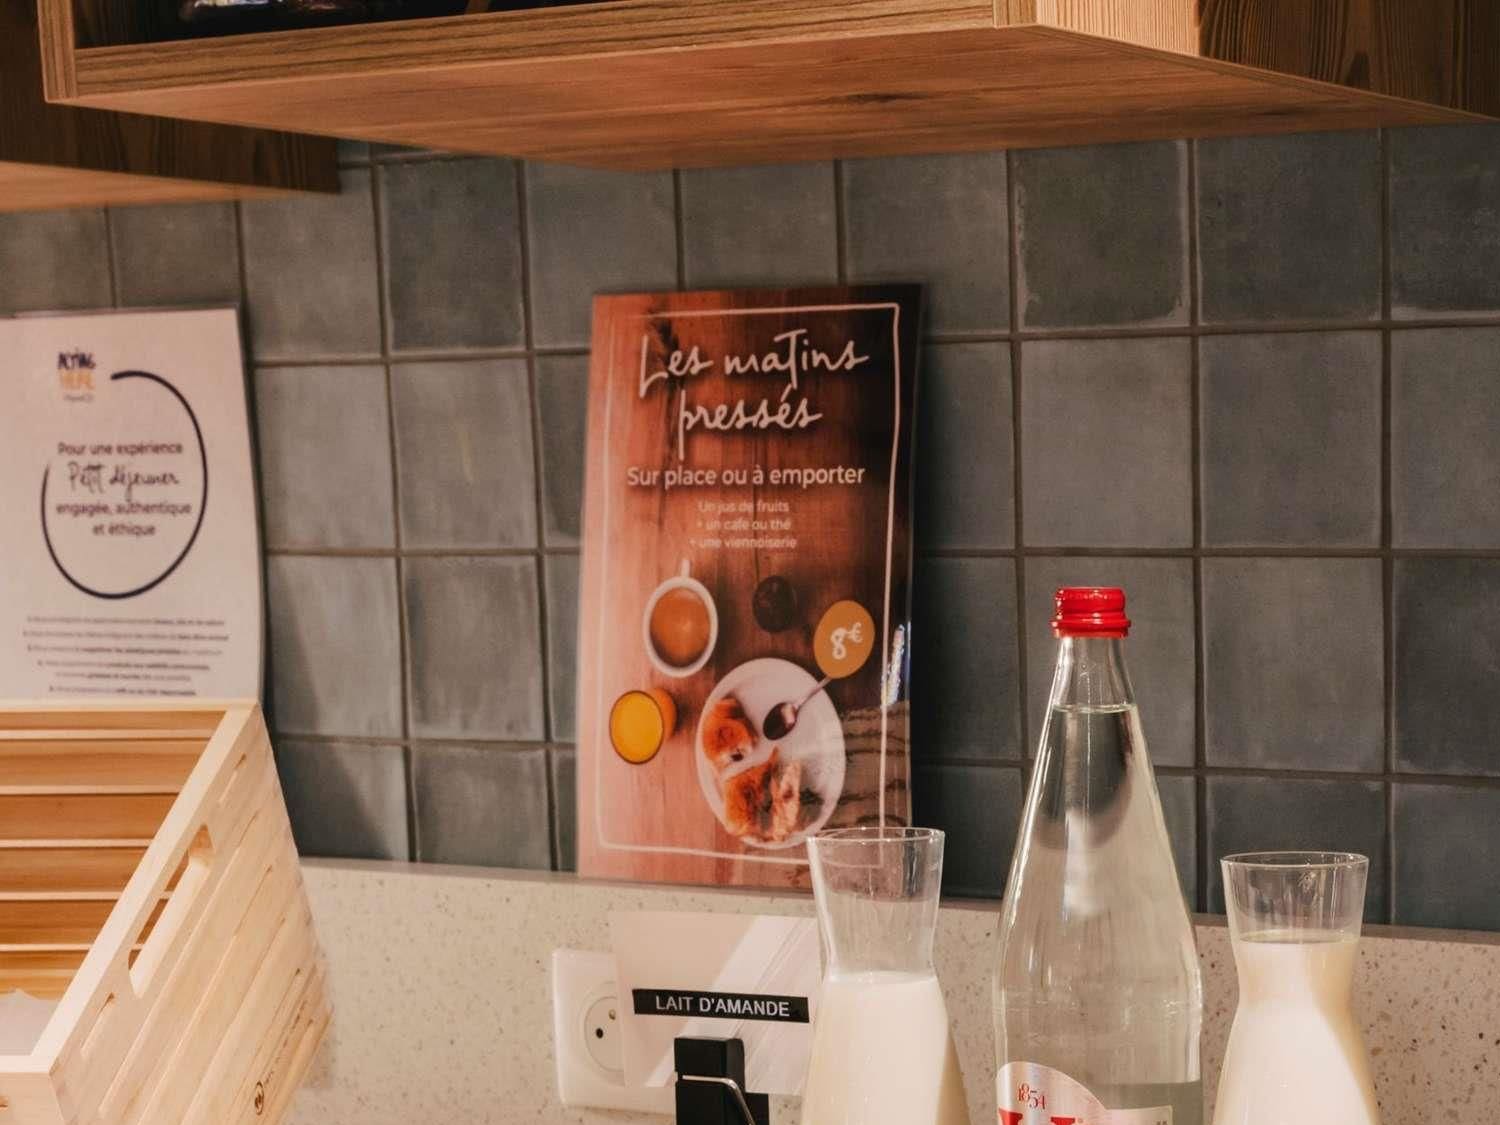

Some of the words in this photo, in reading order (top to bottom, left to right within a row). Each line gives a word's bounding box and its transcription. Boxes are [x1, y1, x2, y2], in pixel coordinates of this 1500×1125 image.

[639, 334, 714, 398] Les
[724, 329, 870, 390] matins
[677, 383, 823, 461] pressés
[57, 441, 86, 455] Pour
[89, 443, 113, 455] une
[116, 442, 183, 457] expérience
[109, 464, 180, 503] déjeuner
[627, 466, 660, 486] Sur
[664, 465, 717, 490] place
[722, 470, 748, 485] ou
[752, 465, 764, 486] à
[769, 466, 867, 489] emporter
[116, 502, 192, 518] authentique
[756, 500, 790, 513] fruits
[92, 523, 105, 536] et
[107, 522, 156, 537] éthique
[752, 519, 768, 531] ou
[770, 516, 792, 531] thé
[723, 535, 798, 550] viennoiserie
[655, 995, 694, 1012] LAIT
[699, 996, 790, 1018] D'AMANDE
